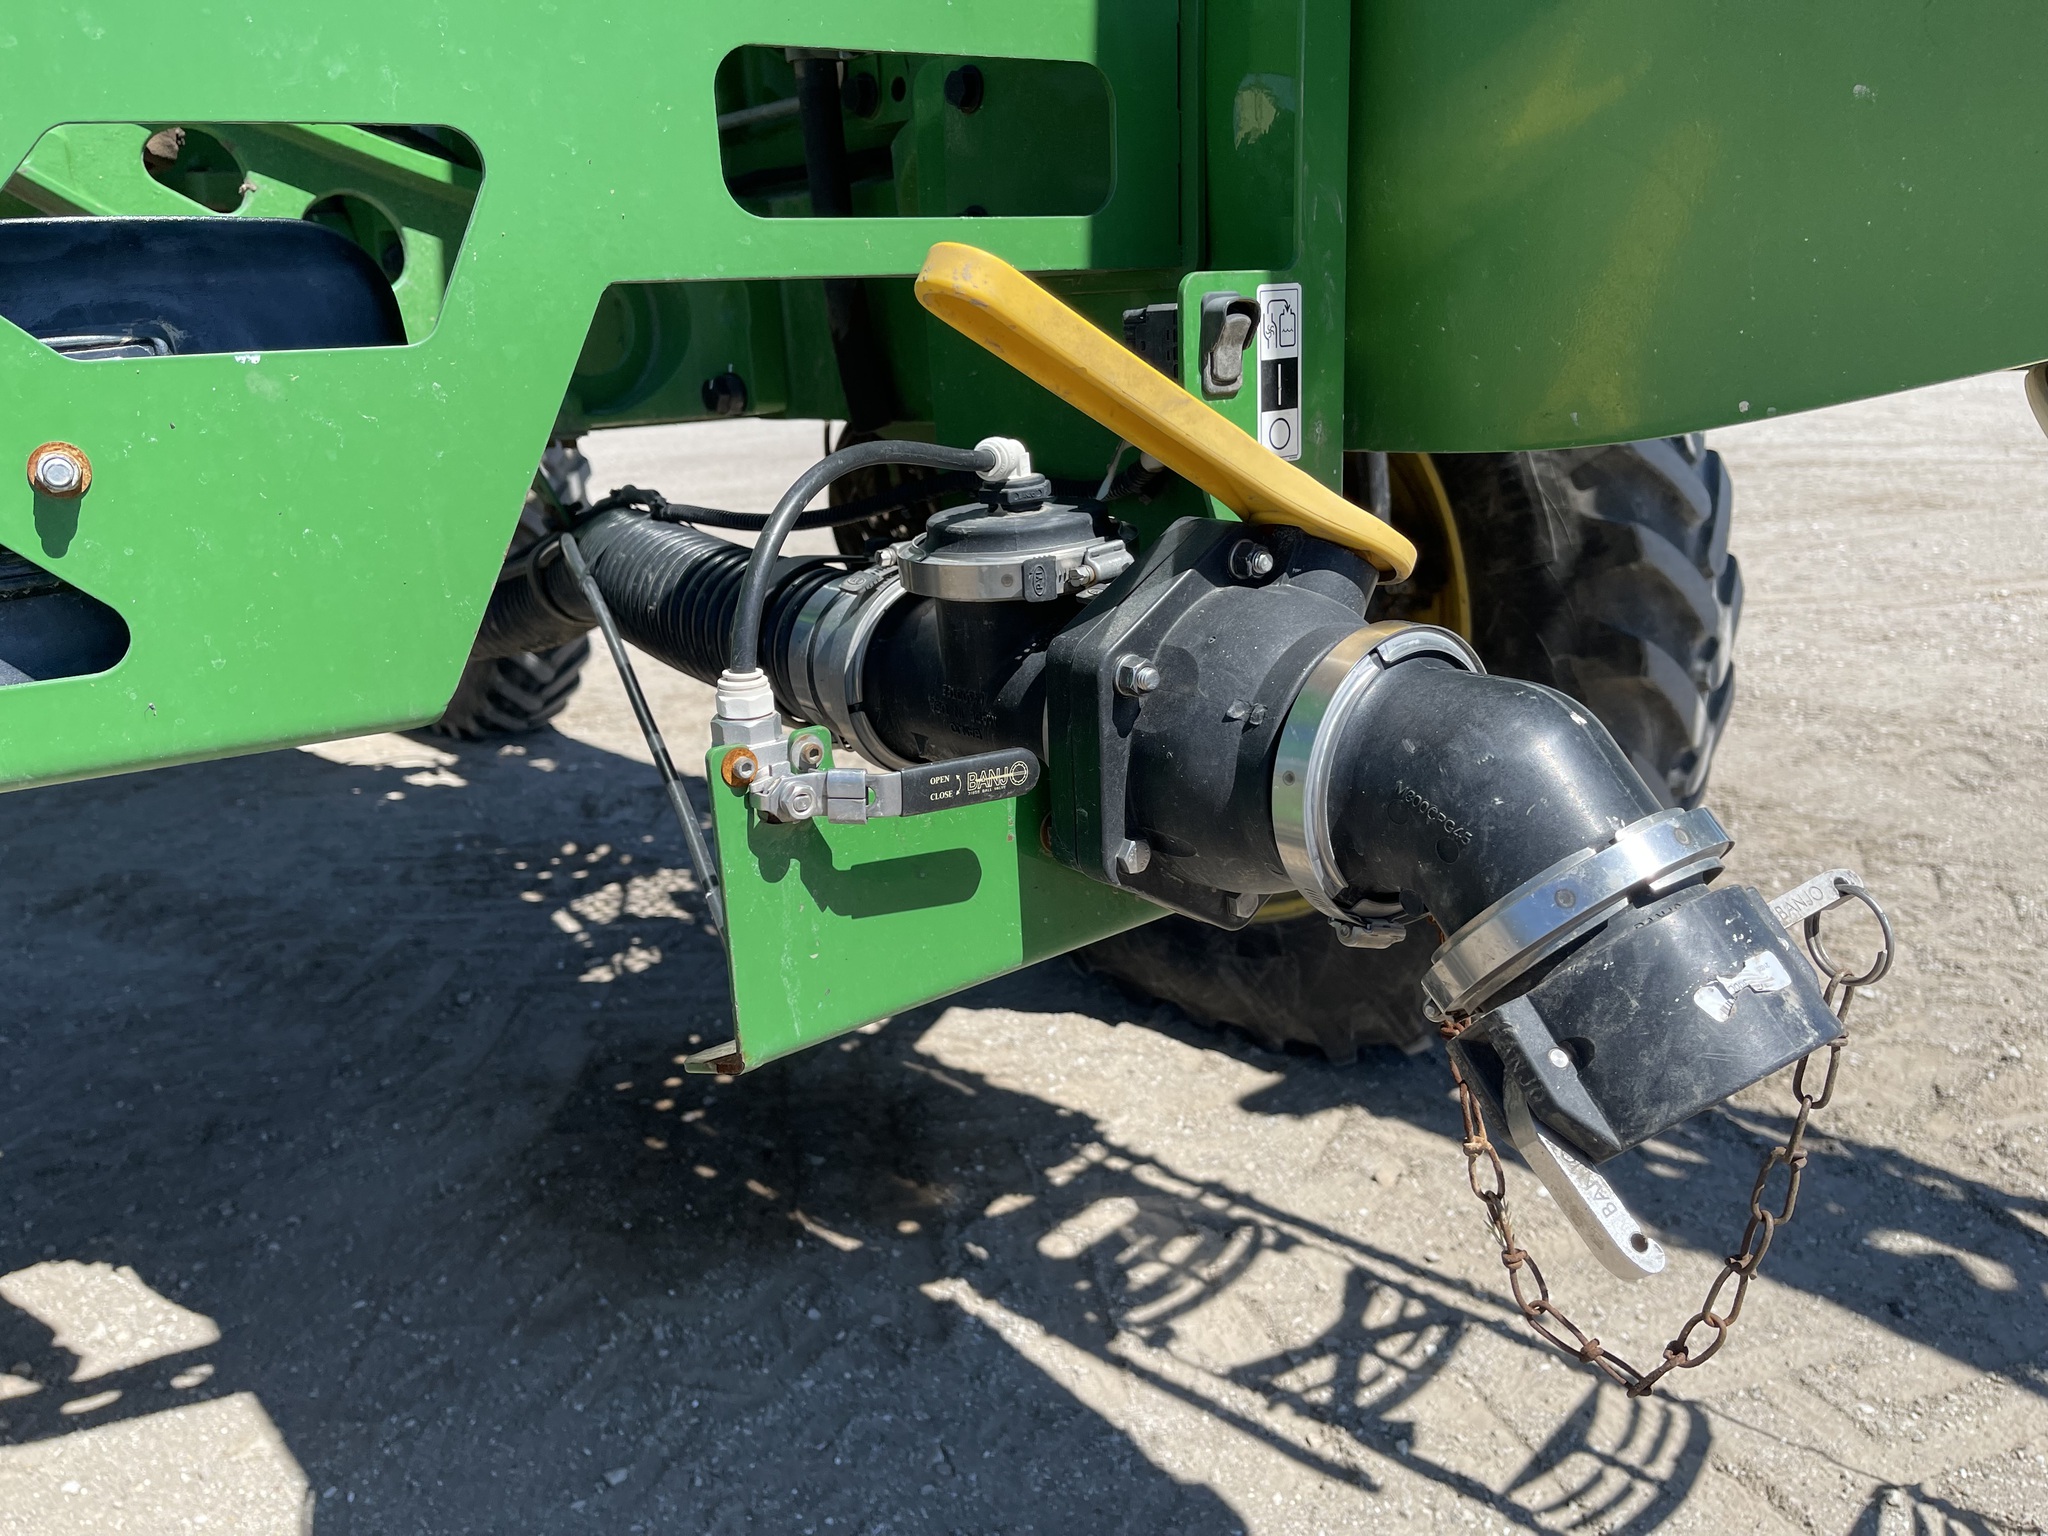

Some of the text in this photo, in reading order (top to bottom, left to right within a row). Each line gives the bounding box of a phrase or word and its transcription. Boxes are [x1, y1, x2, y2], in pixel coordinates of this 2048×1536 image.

[929, 774, 950, 785] OPEN
[966, 760, 1029, 791] BANJO
[929, 790, 954, 801] CLOSE
[1774, 886, 1824, 921] BANJO
